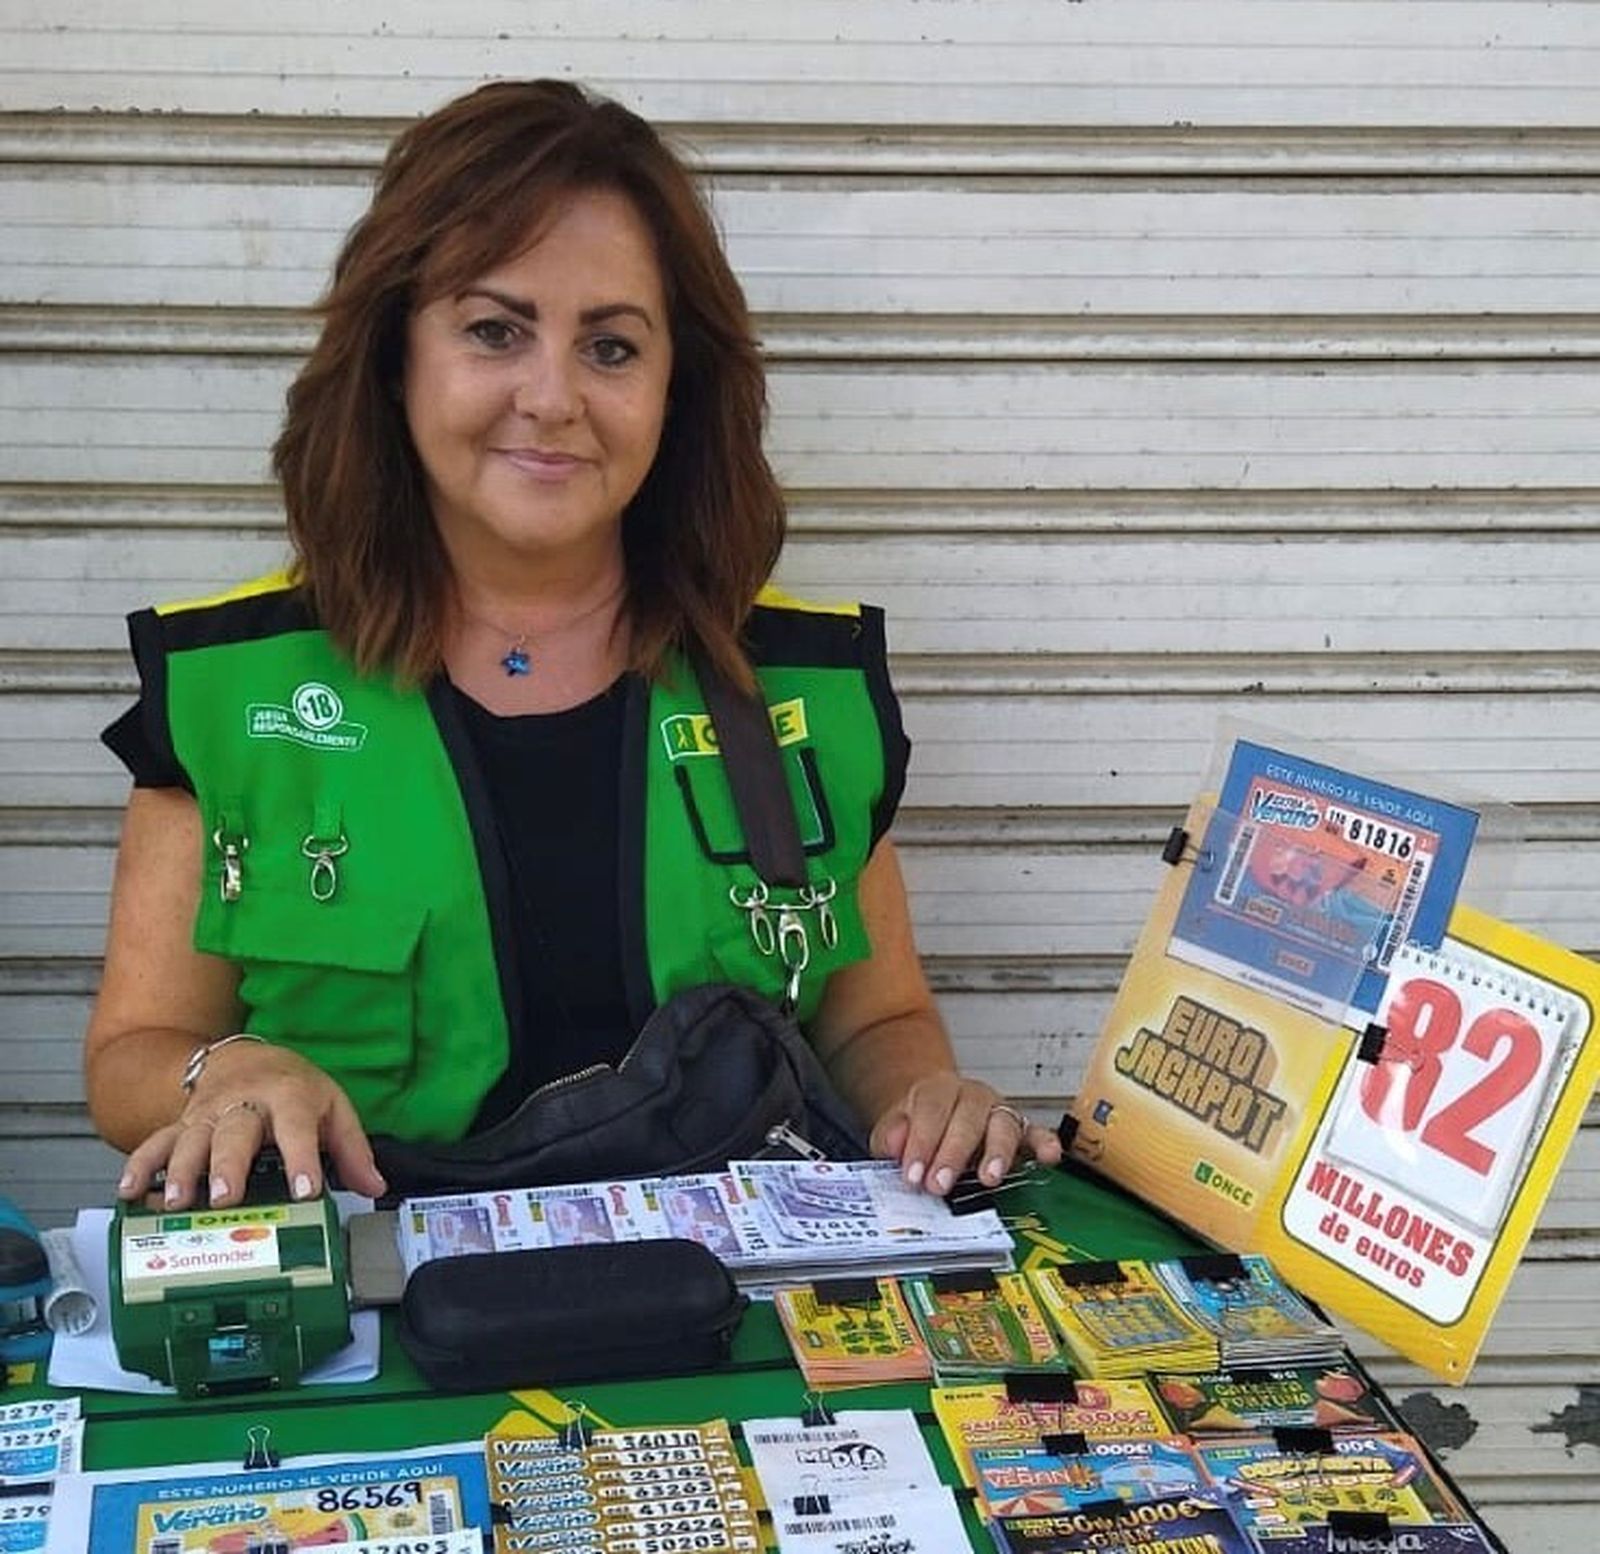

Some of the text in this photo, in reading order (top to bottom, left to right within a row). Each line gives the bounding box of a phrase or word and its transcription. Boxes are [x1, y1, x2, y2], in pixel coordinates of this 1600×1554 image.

[1349, 818, 1411, 858] 81816
[1164, 996, 1267, 1085] EURO
[1115, 1027, 1287, 1153] JACKPOT
[1359, 977, 1543, 1177] 82
[1212, 1172, 1253, 1207] ONCE
[197, 1210, 281, 1226] ONCE
[1306, 1161, 1475, 1278] MILLONES
[170, 1249, 255, 1269] Santander
[1318, 1211, 1426, 1289] de euros
[2, 1428, 61, 1447] 1279
[158, 1464, 443, 1499] ESTE NUMERO SE VENDE AQUI
[317, 1480, 424, 1513] 86569
[153, 1506, 268, 1533] Verano
